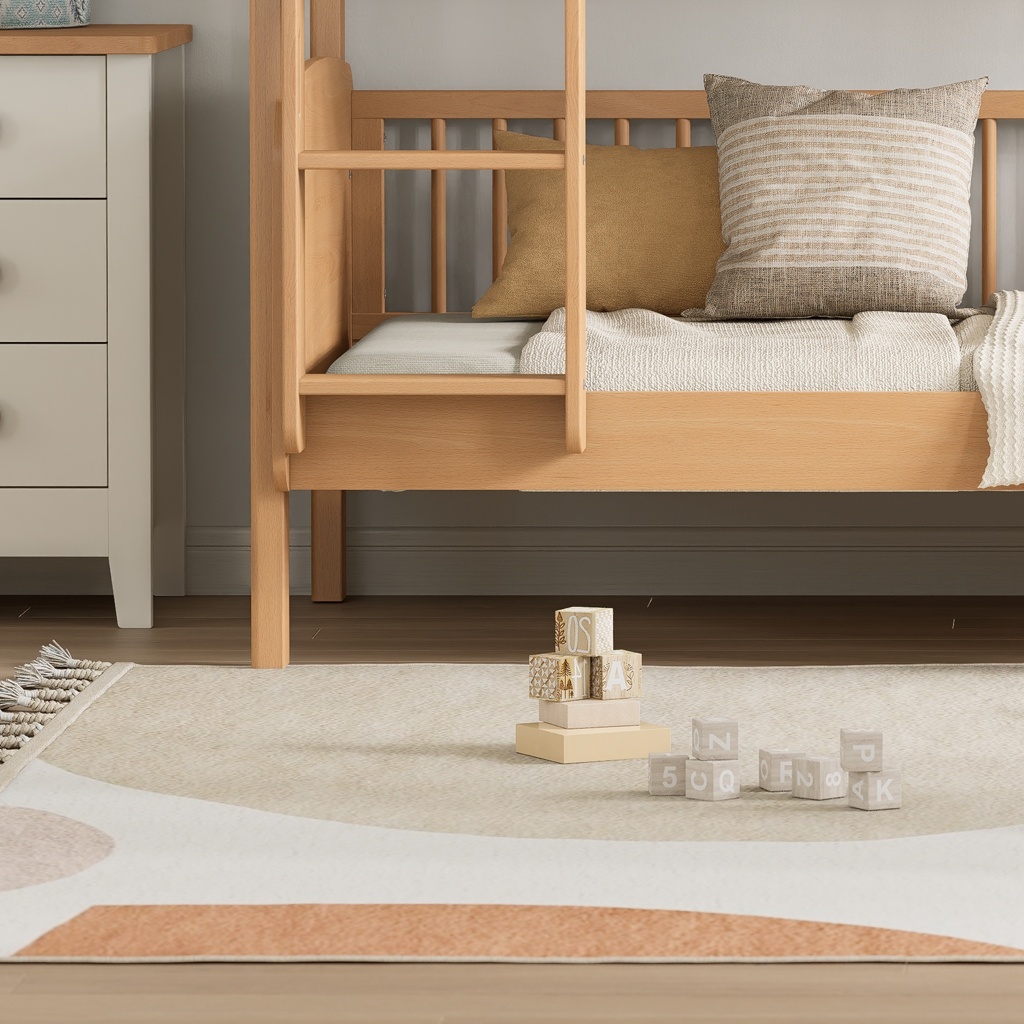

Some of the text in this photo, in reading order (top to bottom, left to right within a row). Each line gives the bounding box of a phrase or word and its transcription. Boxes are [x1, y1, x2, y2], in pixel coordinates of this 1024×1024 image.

[605, 660, 628, 692] A
[852, 744, 876, 763] P
[662, 765, 678, 788] 5
[719, 769, 735, 793] Q
[876, 778, 894, 802] K
